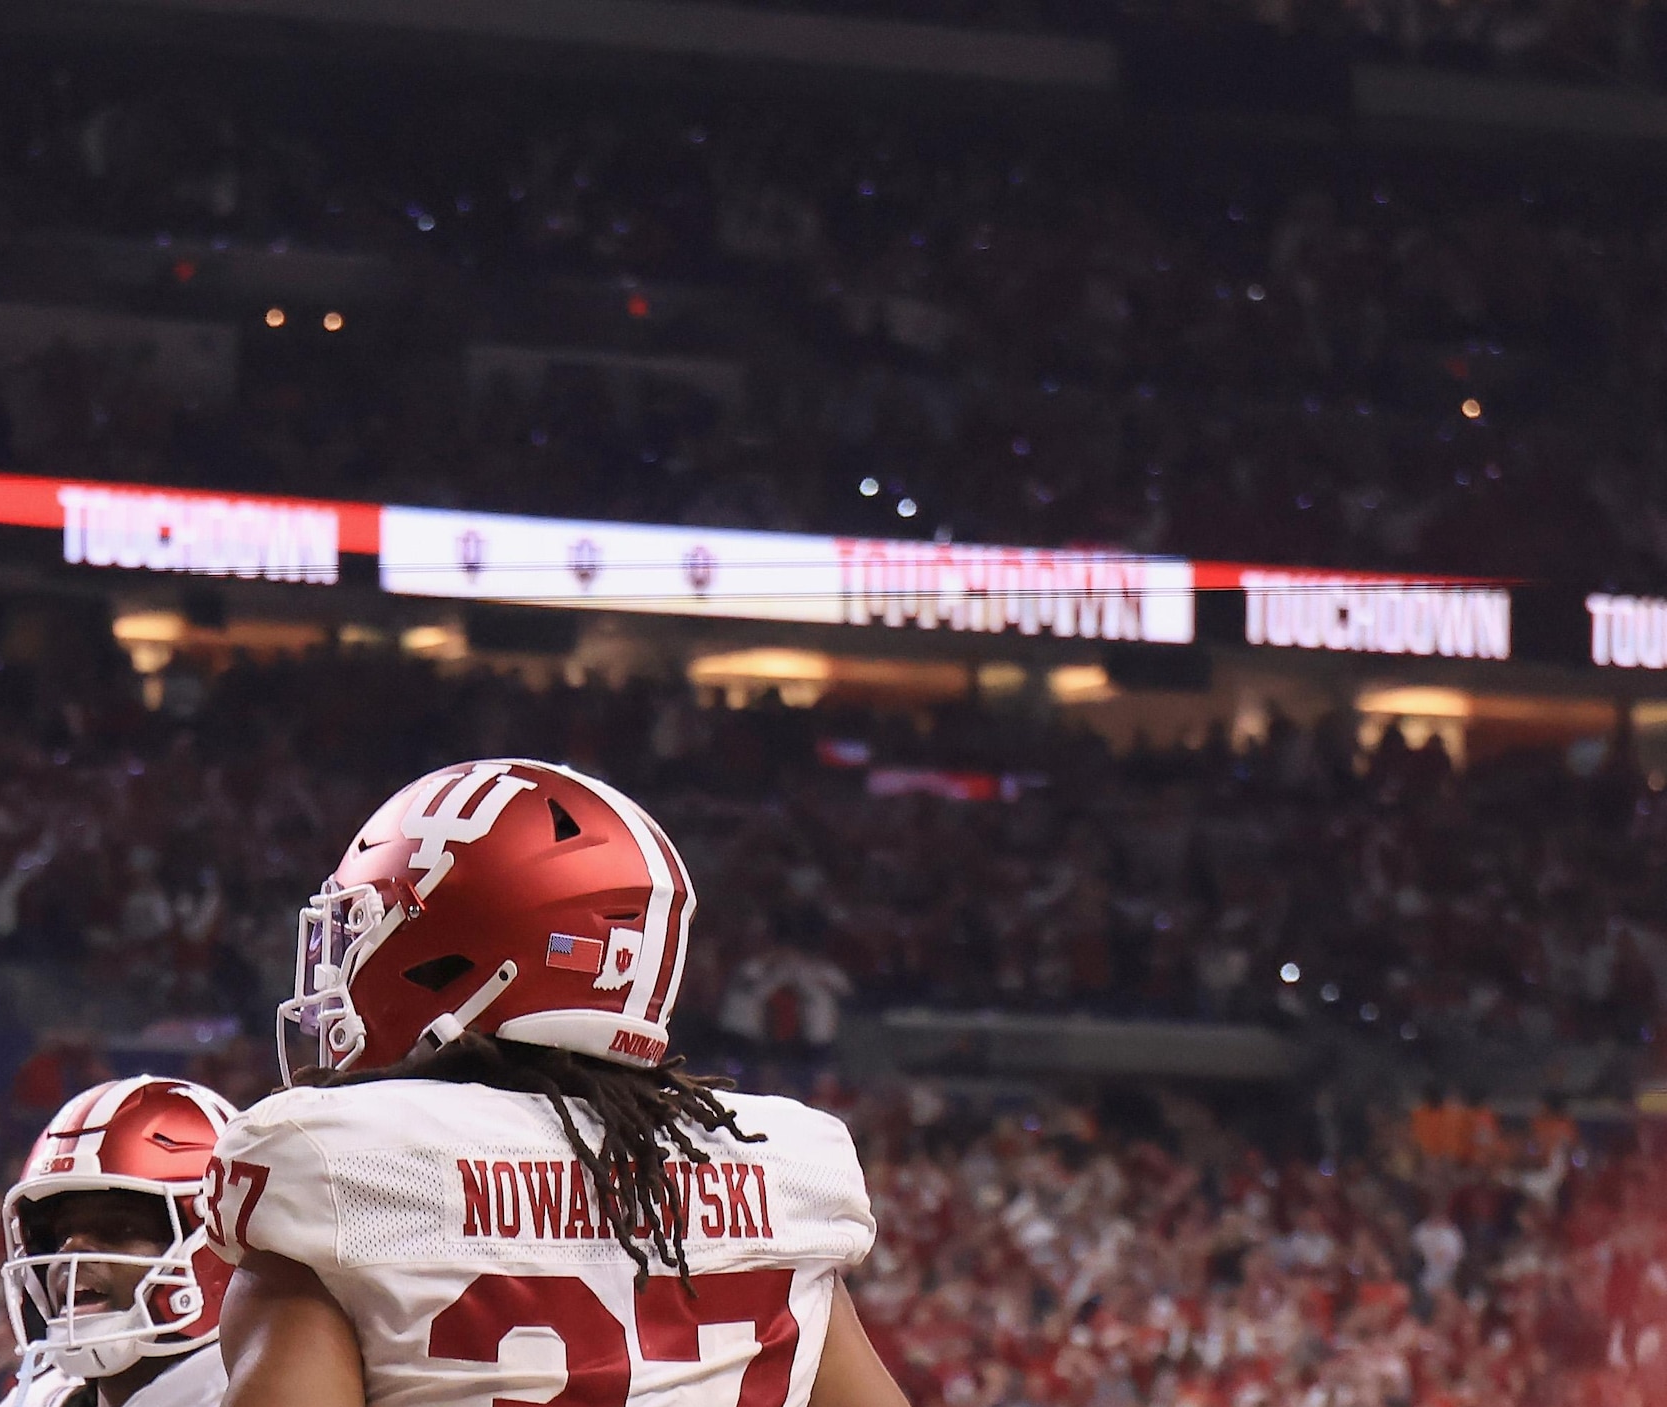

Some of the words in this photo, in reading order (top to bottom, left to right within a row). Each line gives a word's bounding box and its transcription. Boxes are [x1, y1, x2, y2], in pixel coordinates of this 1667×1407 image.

[58, 485, 339, 585] TOUCHDOWN
[1241, 571, 1511, 660] TOUCHDOWN
[609, 1029, 667, 1064] INDIAN
[206, 1156, 271, 1250] 37
